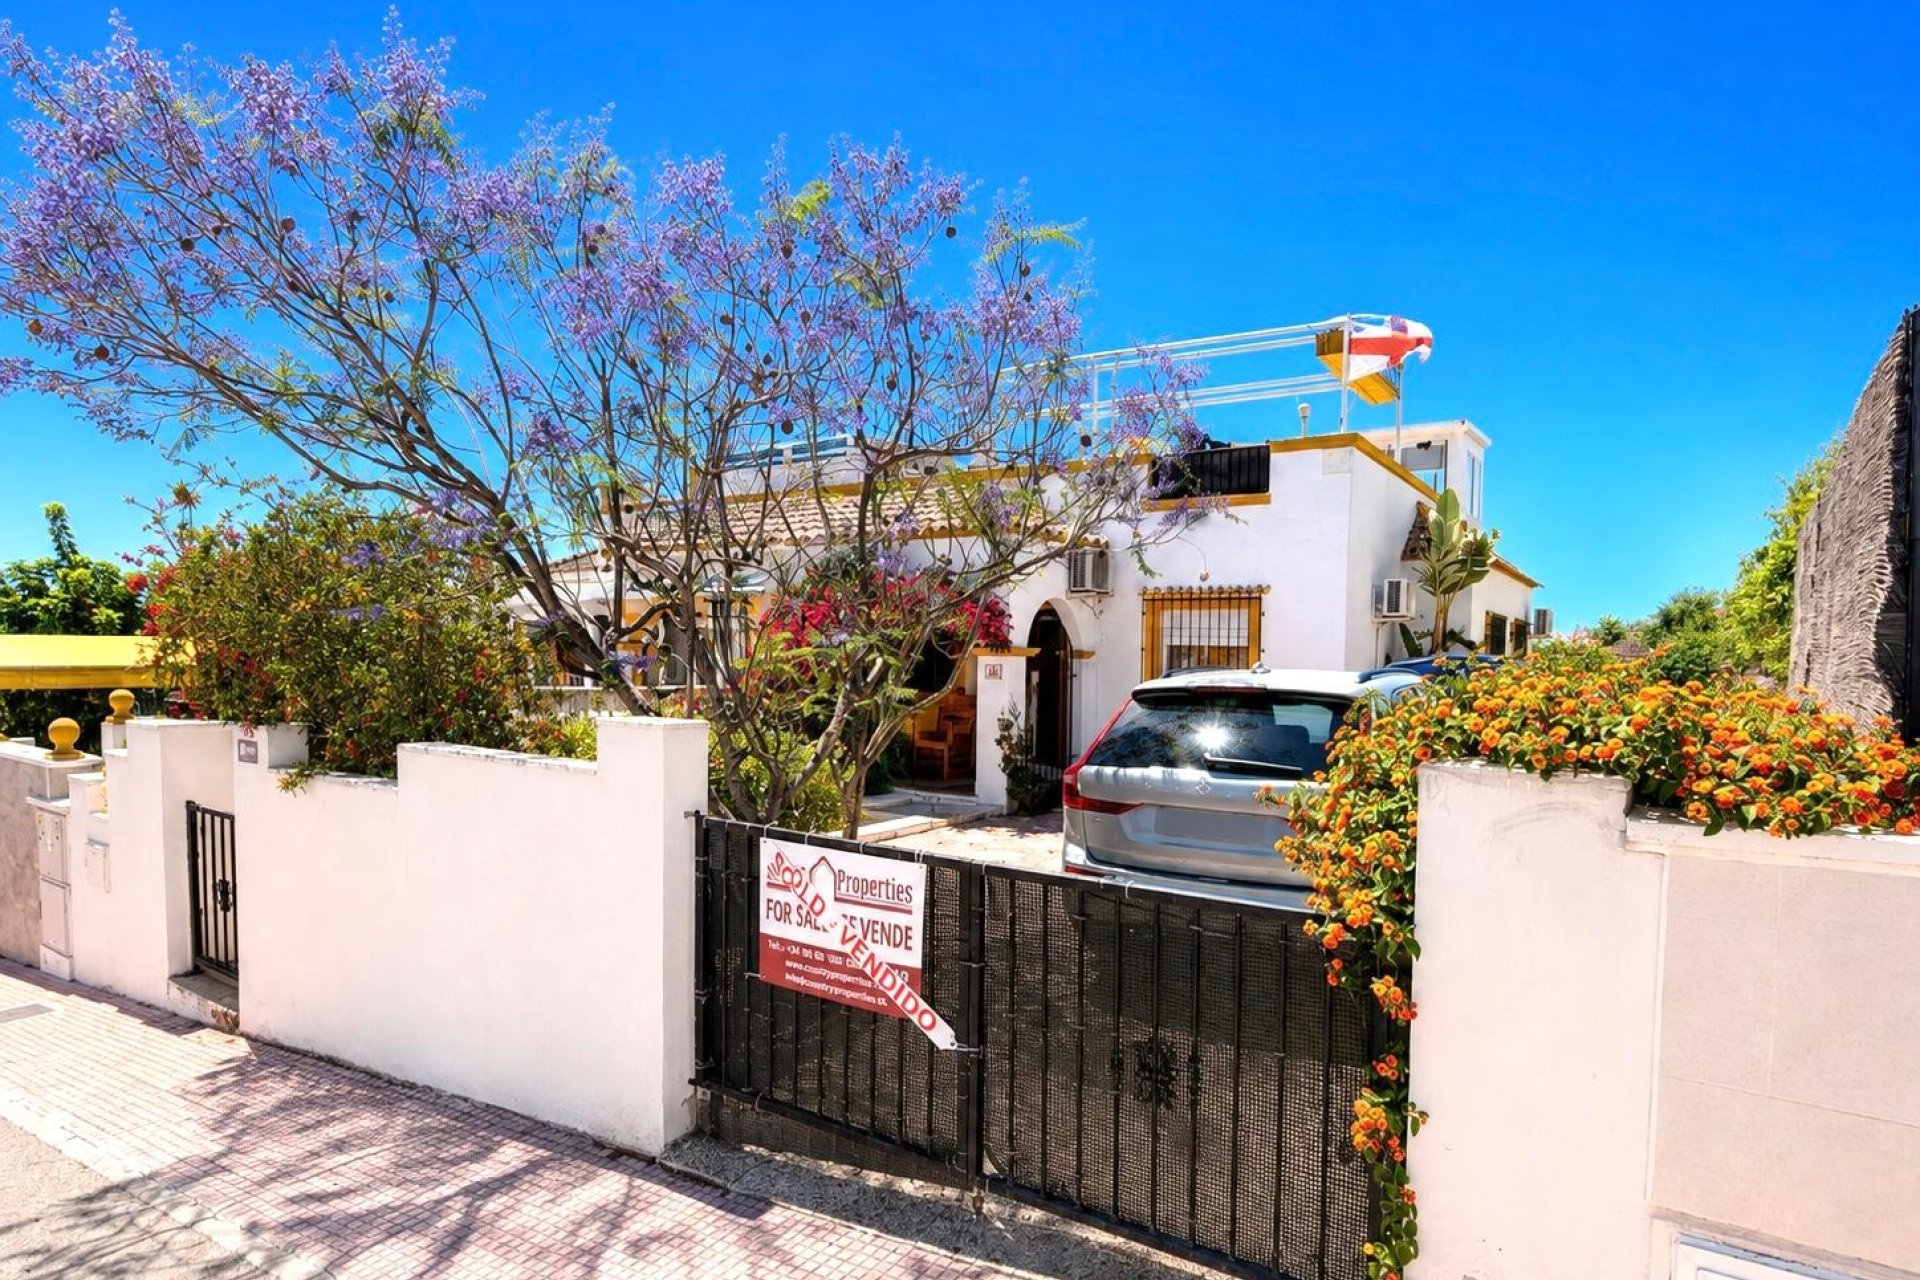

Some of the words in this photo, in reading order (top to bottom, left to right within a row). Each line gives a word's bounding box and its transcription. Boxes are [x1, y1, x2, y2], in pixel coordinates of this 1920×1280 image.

[837, 869, 913, 904] Properties
[766, 898, 792, 925] FOR
[860, 916, 913, 950] VENDE
[840, 925, 937, 1032] VENDIDO
